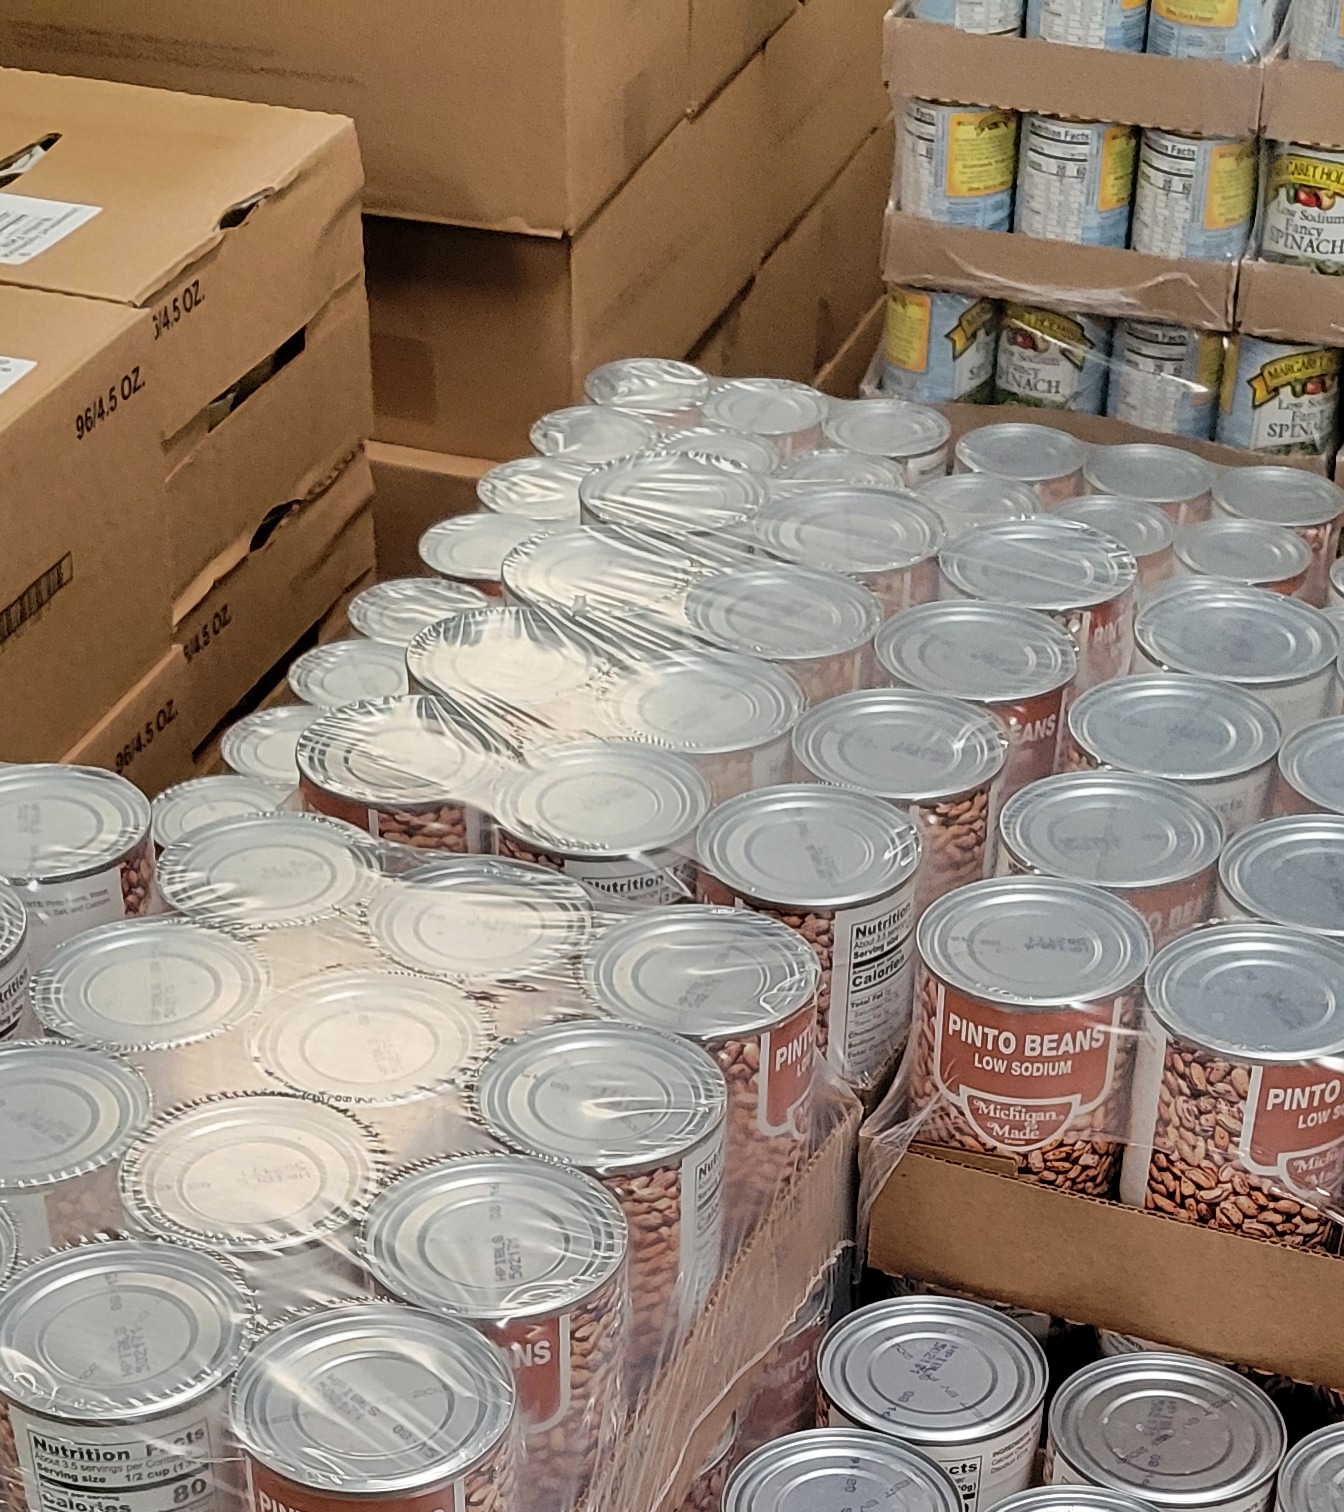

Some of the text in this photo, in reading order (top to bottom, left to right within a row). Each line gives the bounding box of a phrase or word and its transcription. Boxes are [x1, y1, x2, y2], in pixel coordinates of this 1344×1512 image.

[1269, 225, 1344, 255] SPINACH
[1286, 218, 1324, 239] Fancy
[183, 278, 205, 314] OZ.
[75, 365, 146, 440] 96/4.5 OZ.
[947, 1020, 1105, 1058] PINTO BEANS
[972, 1053, 1072, 1076] LOW SODIUM
[1266, 1078, 1341, 1112] PINTO
[972, 1097, 1059, 1125] Michigan
[1297, 1106, 1327, 1130] LOW
[988, 1119, 1041, 1141] Made
[33, 1436, 130, 1462] Nutrition
[173, 1478, 207, 1504] 80
